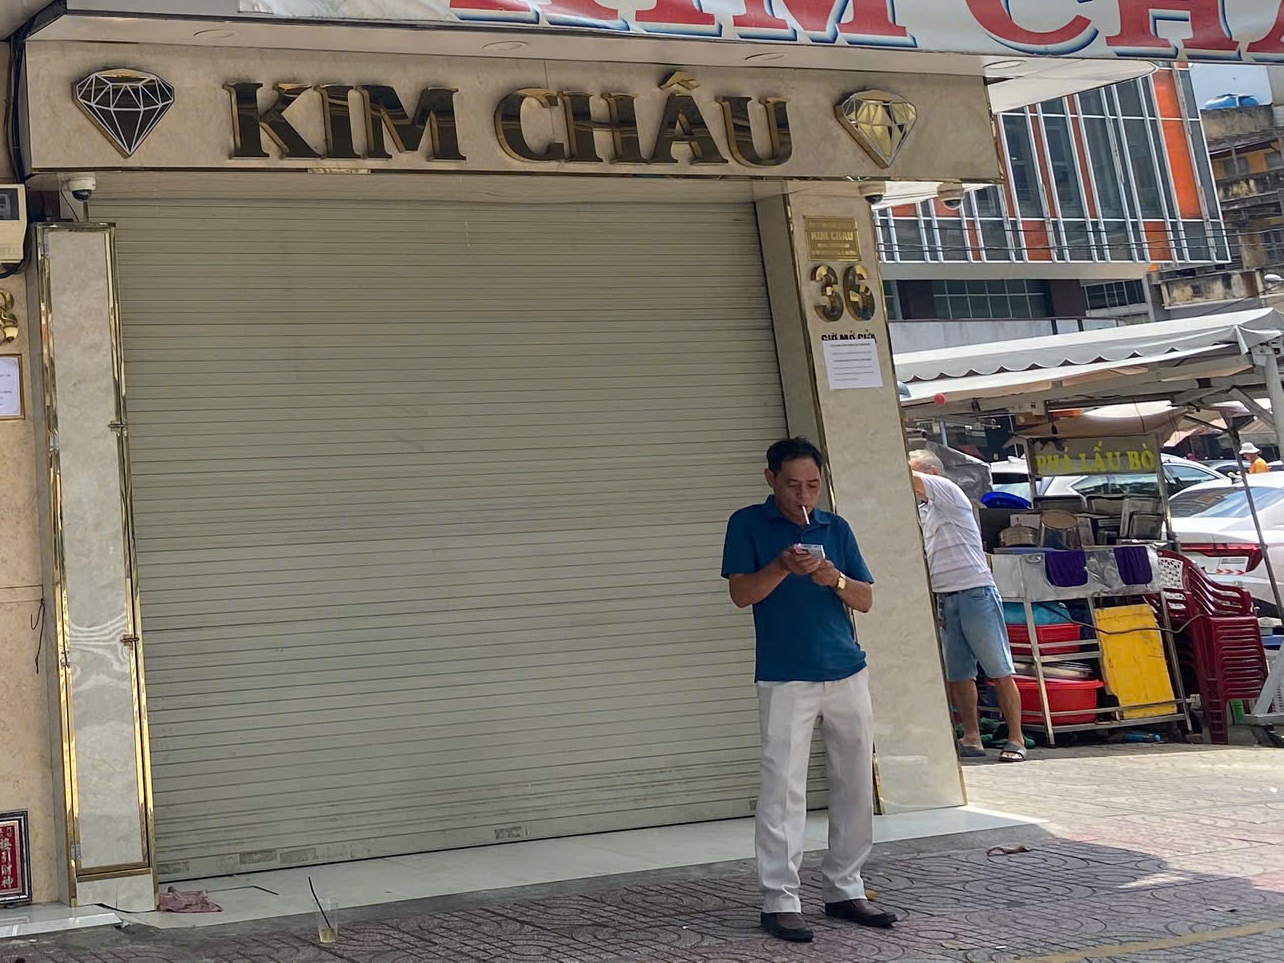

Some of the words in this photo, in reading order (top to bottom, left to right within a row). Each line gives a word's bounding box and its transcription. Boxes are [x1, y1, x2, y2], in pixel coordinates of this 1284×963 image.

[223, 82, 468, 162] KIM
[493, 70, 793, 169] CHÂU
[810, 264, 876, 323] 36
